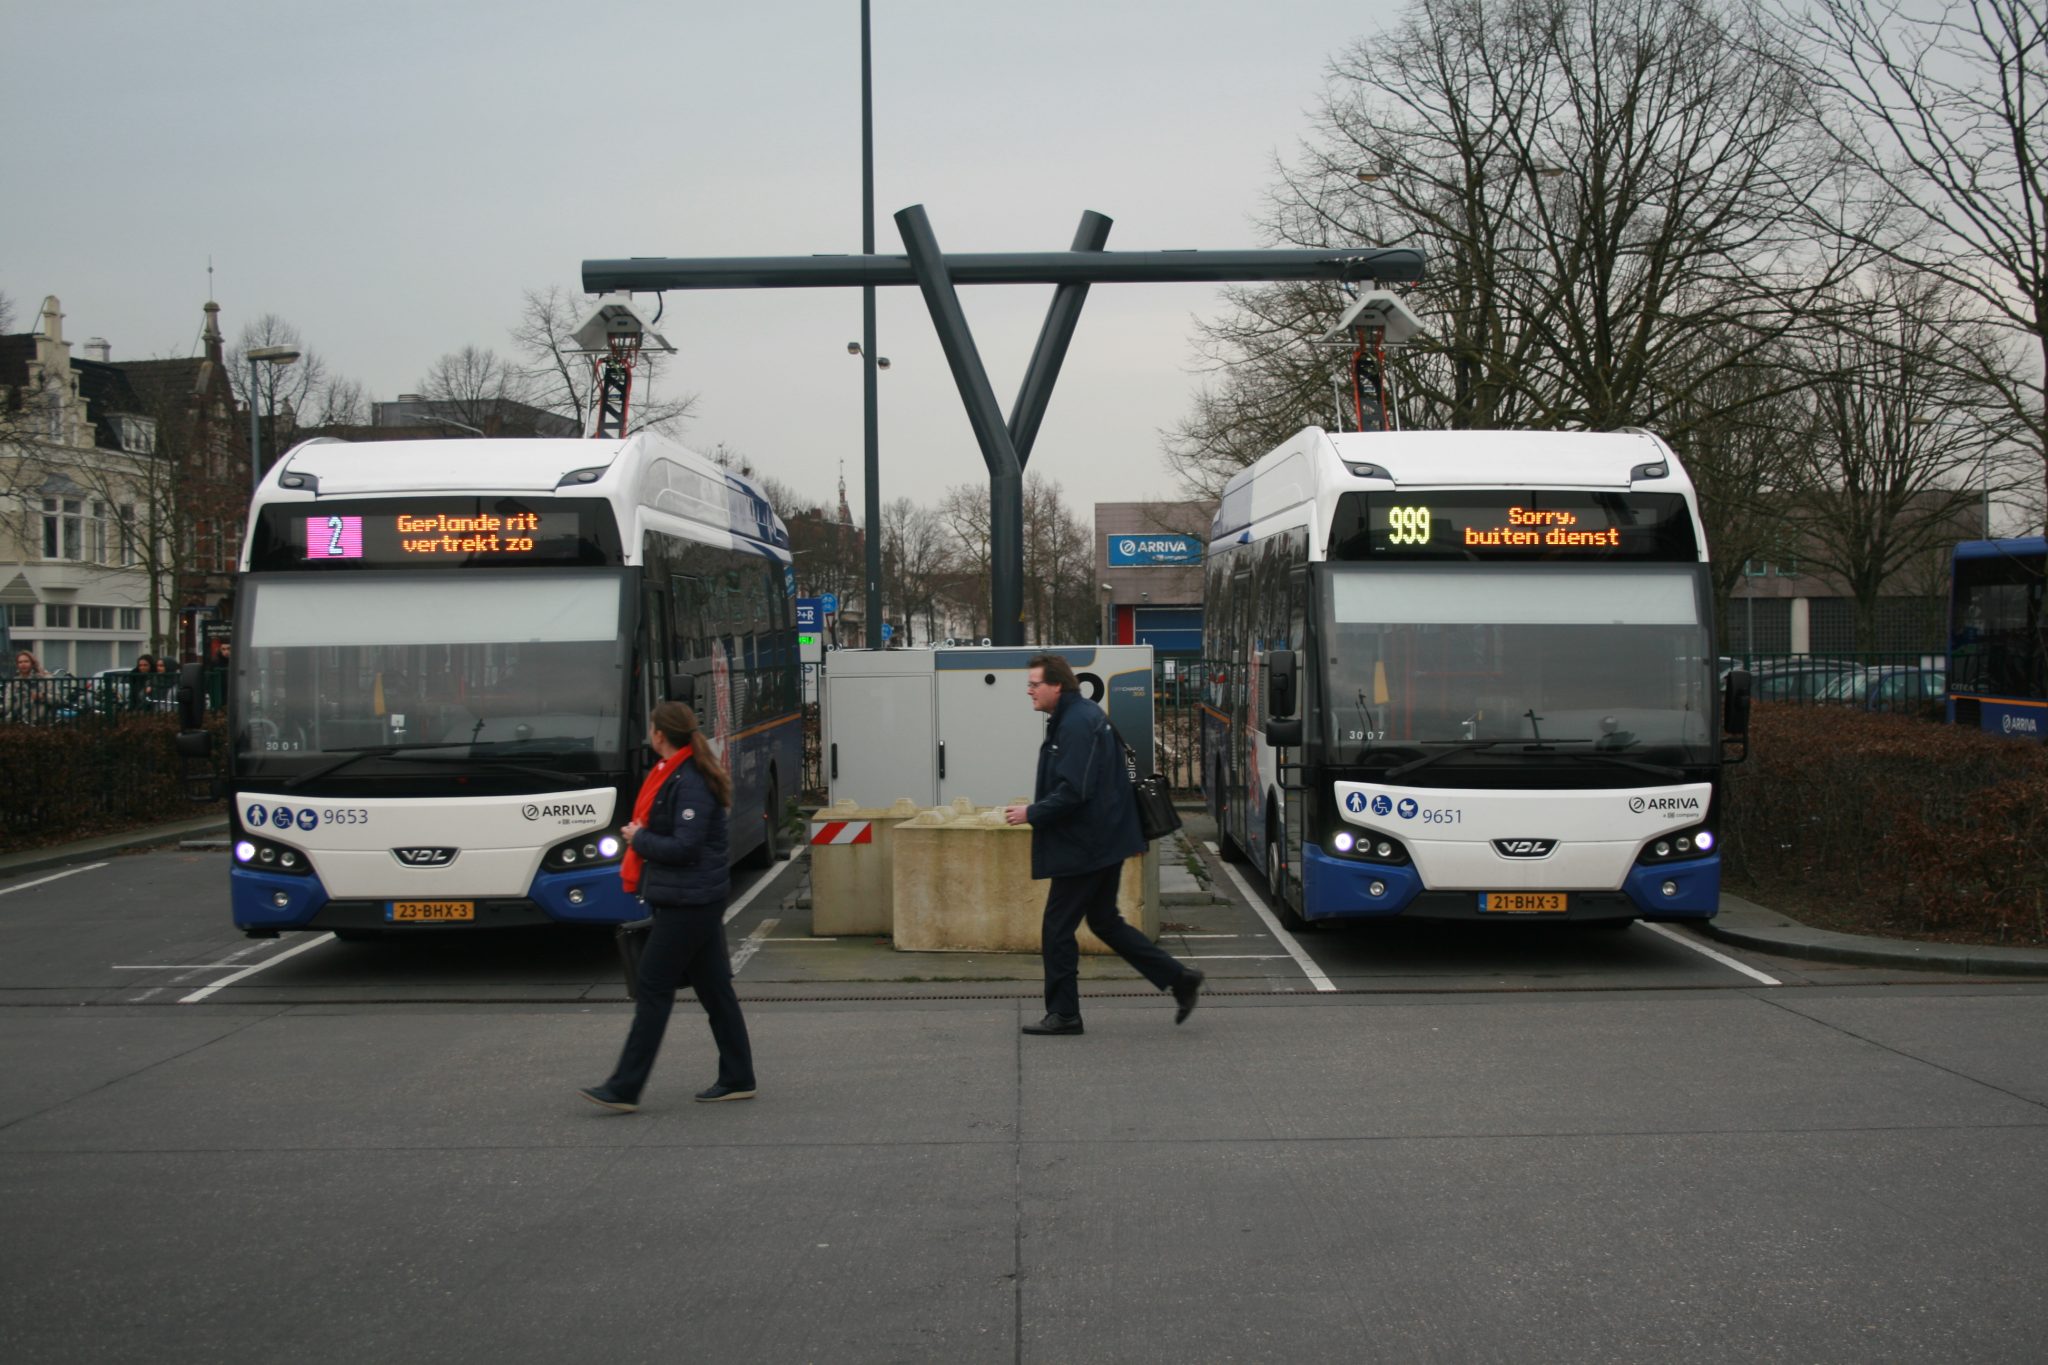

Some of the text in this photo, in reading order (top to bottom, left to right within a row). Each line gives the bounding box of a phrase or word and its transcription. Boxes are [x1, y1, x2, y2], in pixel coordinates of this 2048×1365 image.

[397, 513, 539, 532] Geplande rit
[1508, 507, 1576, 525] Sorry,
[1388, 507, 1430, 545] 999
[327, 516, 344, 554] 2
[1465, 527, 1620, 545] buiten dienst
[402, 534, 534, 552] vertrekt zo
[1137, 541, 1187, 553] ARRIVA
[2010, 717, 2037, 732] ARRIVA
[542, 804, 596, 817] ARRIVA
[1648, 797, 1699, 810] ARRIVA
[323, 809, 369, 825] 9653
[1422, 809, 1463, 824] 9651
[1501, 841, 1547, 853] VDL
[401, 850, 447, 862] VDL
[1493, 895, 1560, 910] 21-BHX-3
[399, 904, 468, 919] 23-BHX-3
